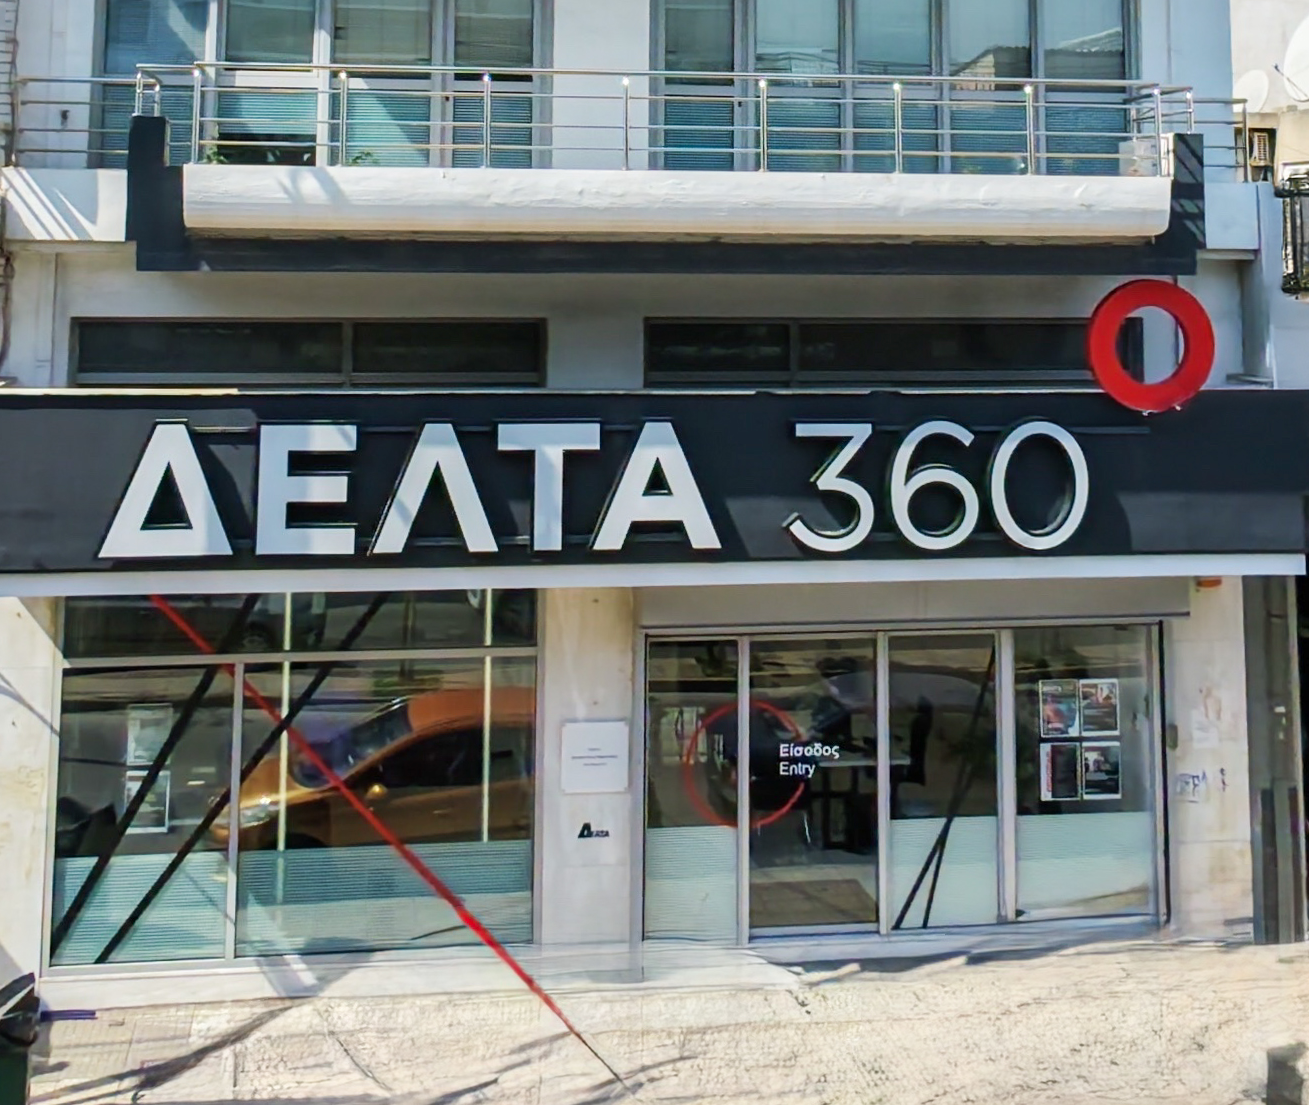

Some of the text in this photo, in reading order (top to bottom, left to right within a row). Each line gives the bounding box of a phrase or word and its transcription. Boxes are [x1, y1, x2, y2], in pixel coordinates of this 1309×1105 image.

[97, 419, 1090, 558] ΔΕΛΤΑ 360
[779, 742, 840, 759] Είσοδος
[779, 761, 816, 778] Entry
